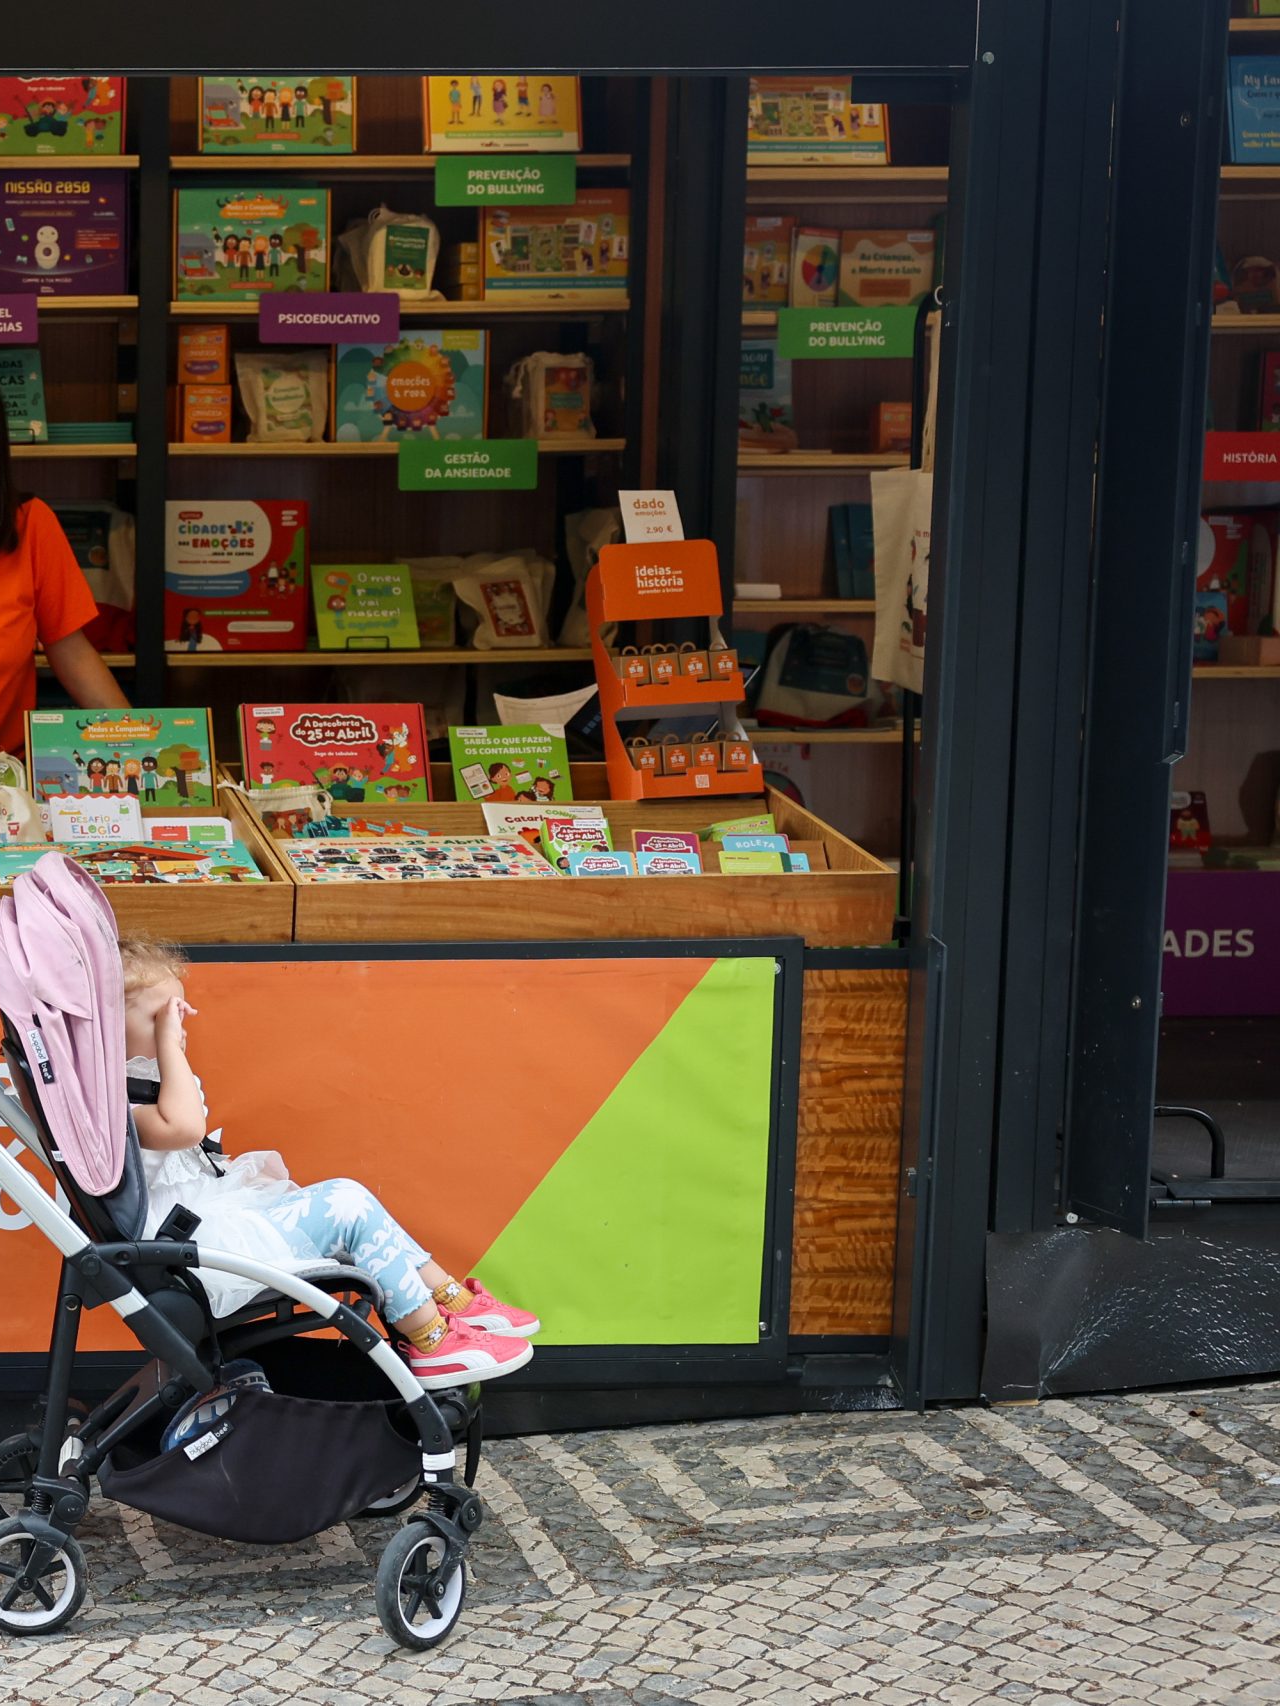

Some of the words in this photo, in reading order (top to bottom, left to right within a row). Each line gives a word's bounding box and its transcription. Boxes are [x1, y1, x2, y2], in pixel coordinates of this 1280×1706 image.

[468, 167, 541, 181] PREVENÇÃO
[467, 185, 486, 194] DO
[488, 184, 544, 194] BULLYING
[278, 313, 380, 324] PSICOEDUCATIVO
[809, 320, 882, 333] PREVENÇÃO
[809, 337, 826, 347] DO
[829, 336, 885, 347] BULLYING
[391, 375, 431, 389] emoções
[444, 452, 490, 465] GESTÃO
[1222, 451, 1277, 464] HISTÓRIA
[425, 468, 442, 479] DA
[444, 467, 511, 478] ANSIEDADE
[633, 498, 665, 509] dado
[179, 521, 226, 534] CIDADE
[192, 536, 254, 550] EMOÇÕES
[635, 565, 671, 576] ideias
[636, 576, 684, 588] história
[313, 719, 360, 727] Descoberta
[307, 729, 323, 741] 25
[337, 727, 371, 739] Abril
[502, 736, 520, 744] QUE
[479, 746, 552, 755] CONTABILISTAS?
[505, 815, 549, 823] Catari
[582, 832, 602, 840] Abril
[736, 839, 775, 849] ROLETA
[1163, 929, 1255, 958] ADES
